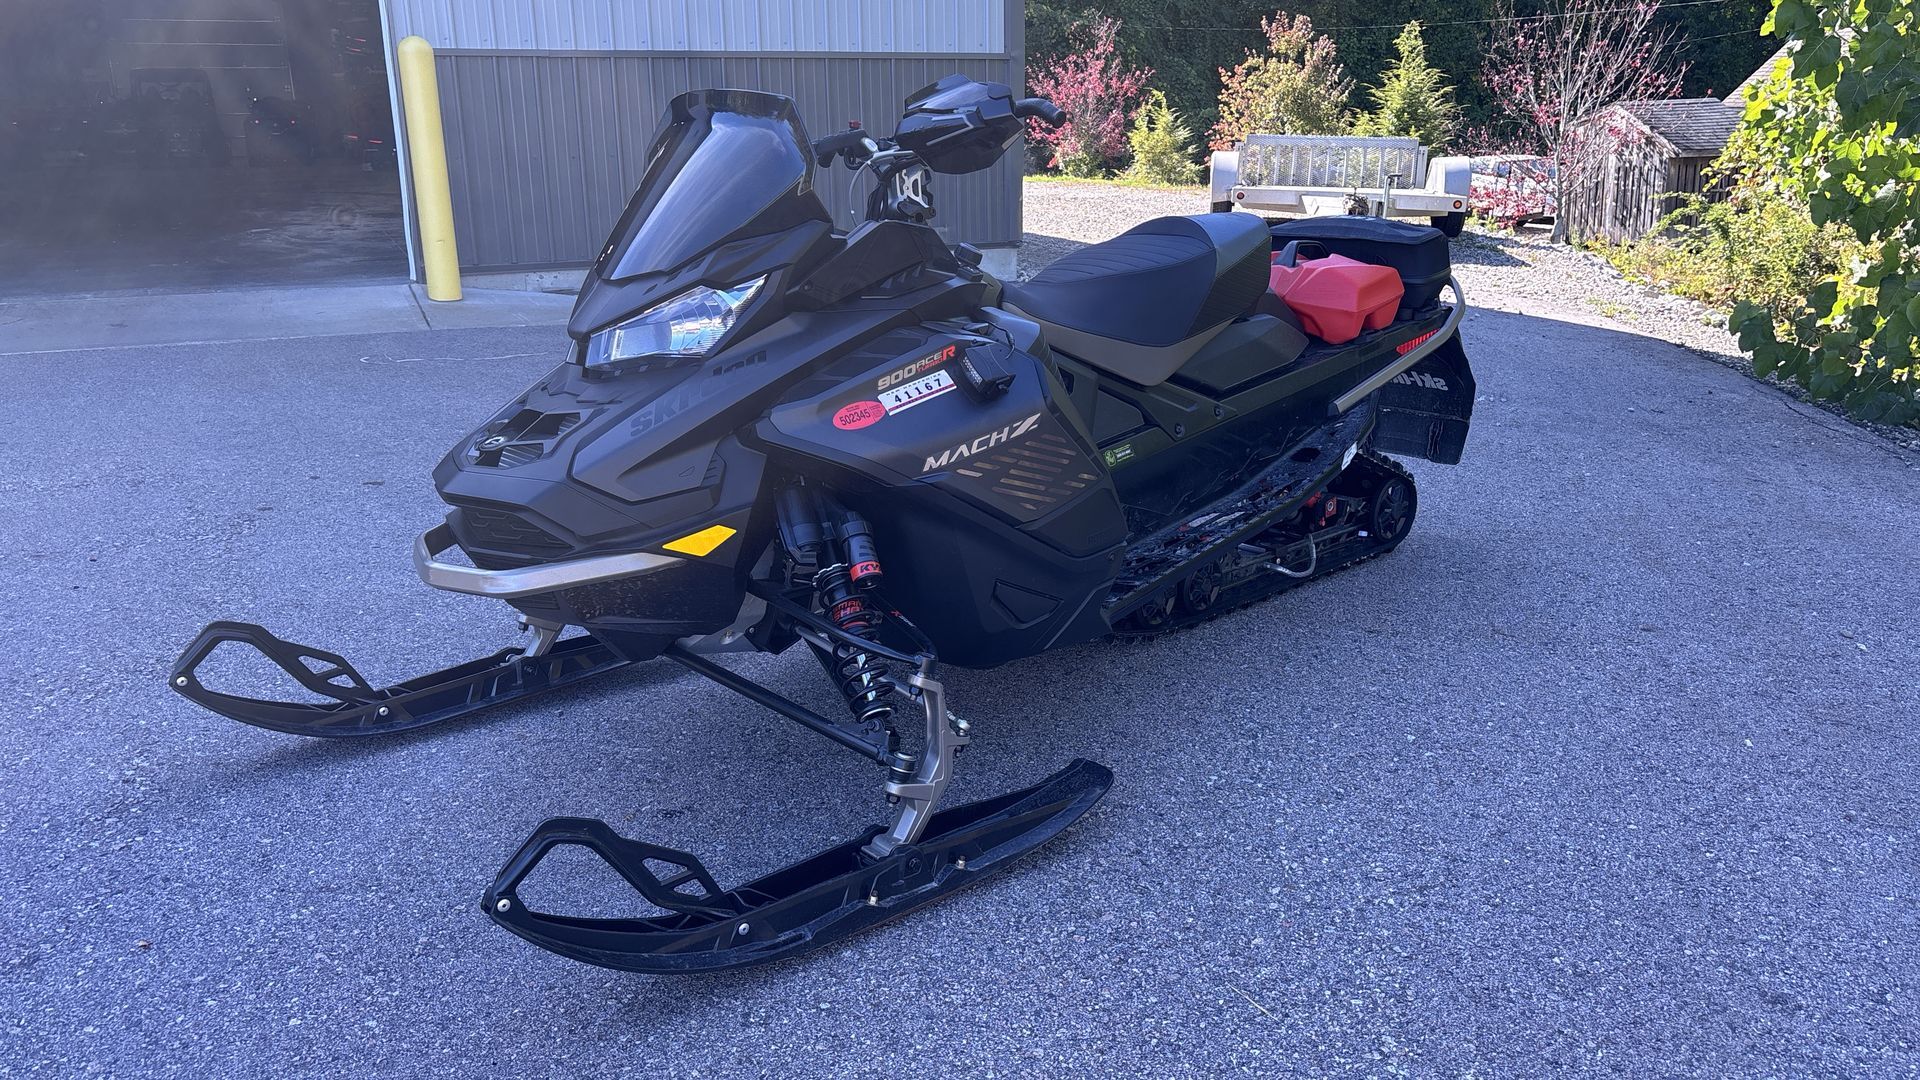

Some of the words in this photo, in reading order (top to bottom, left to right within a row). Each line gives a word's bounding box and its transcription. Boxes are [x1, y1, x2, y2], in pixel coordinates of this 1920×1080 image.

[877, 363, 917, 391] 900
[916, 351, 943, 368] ACE
[942, 344, 956, 361] R
[894, 378, 942, 404] 41167
[839, 409, 871, 426] 502345
[922, 426, 1010, 473] MACH
[1009, 412, 1041, 439] Z
